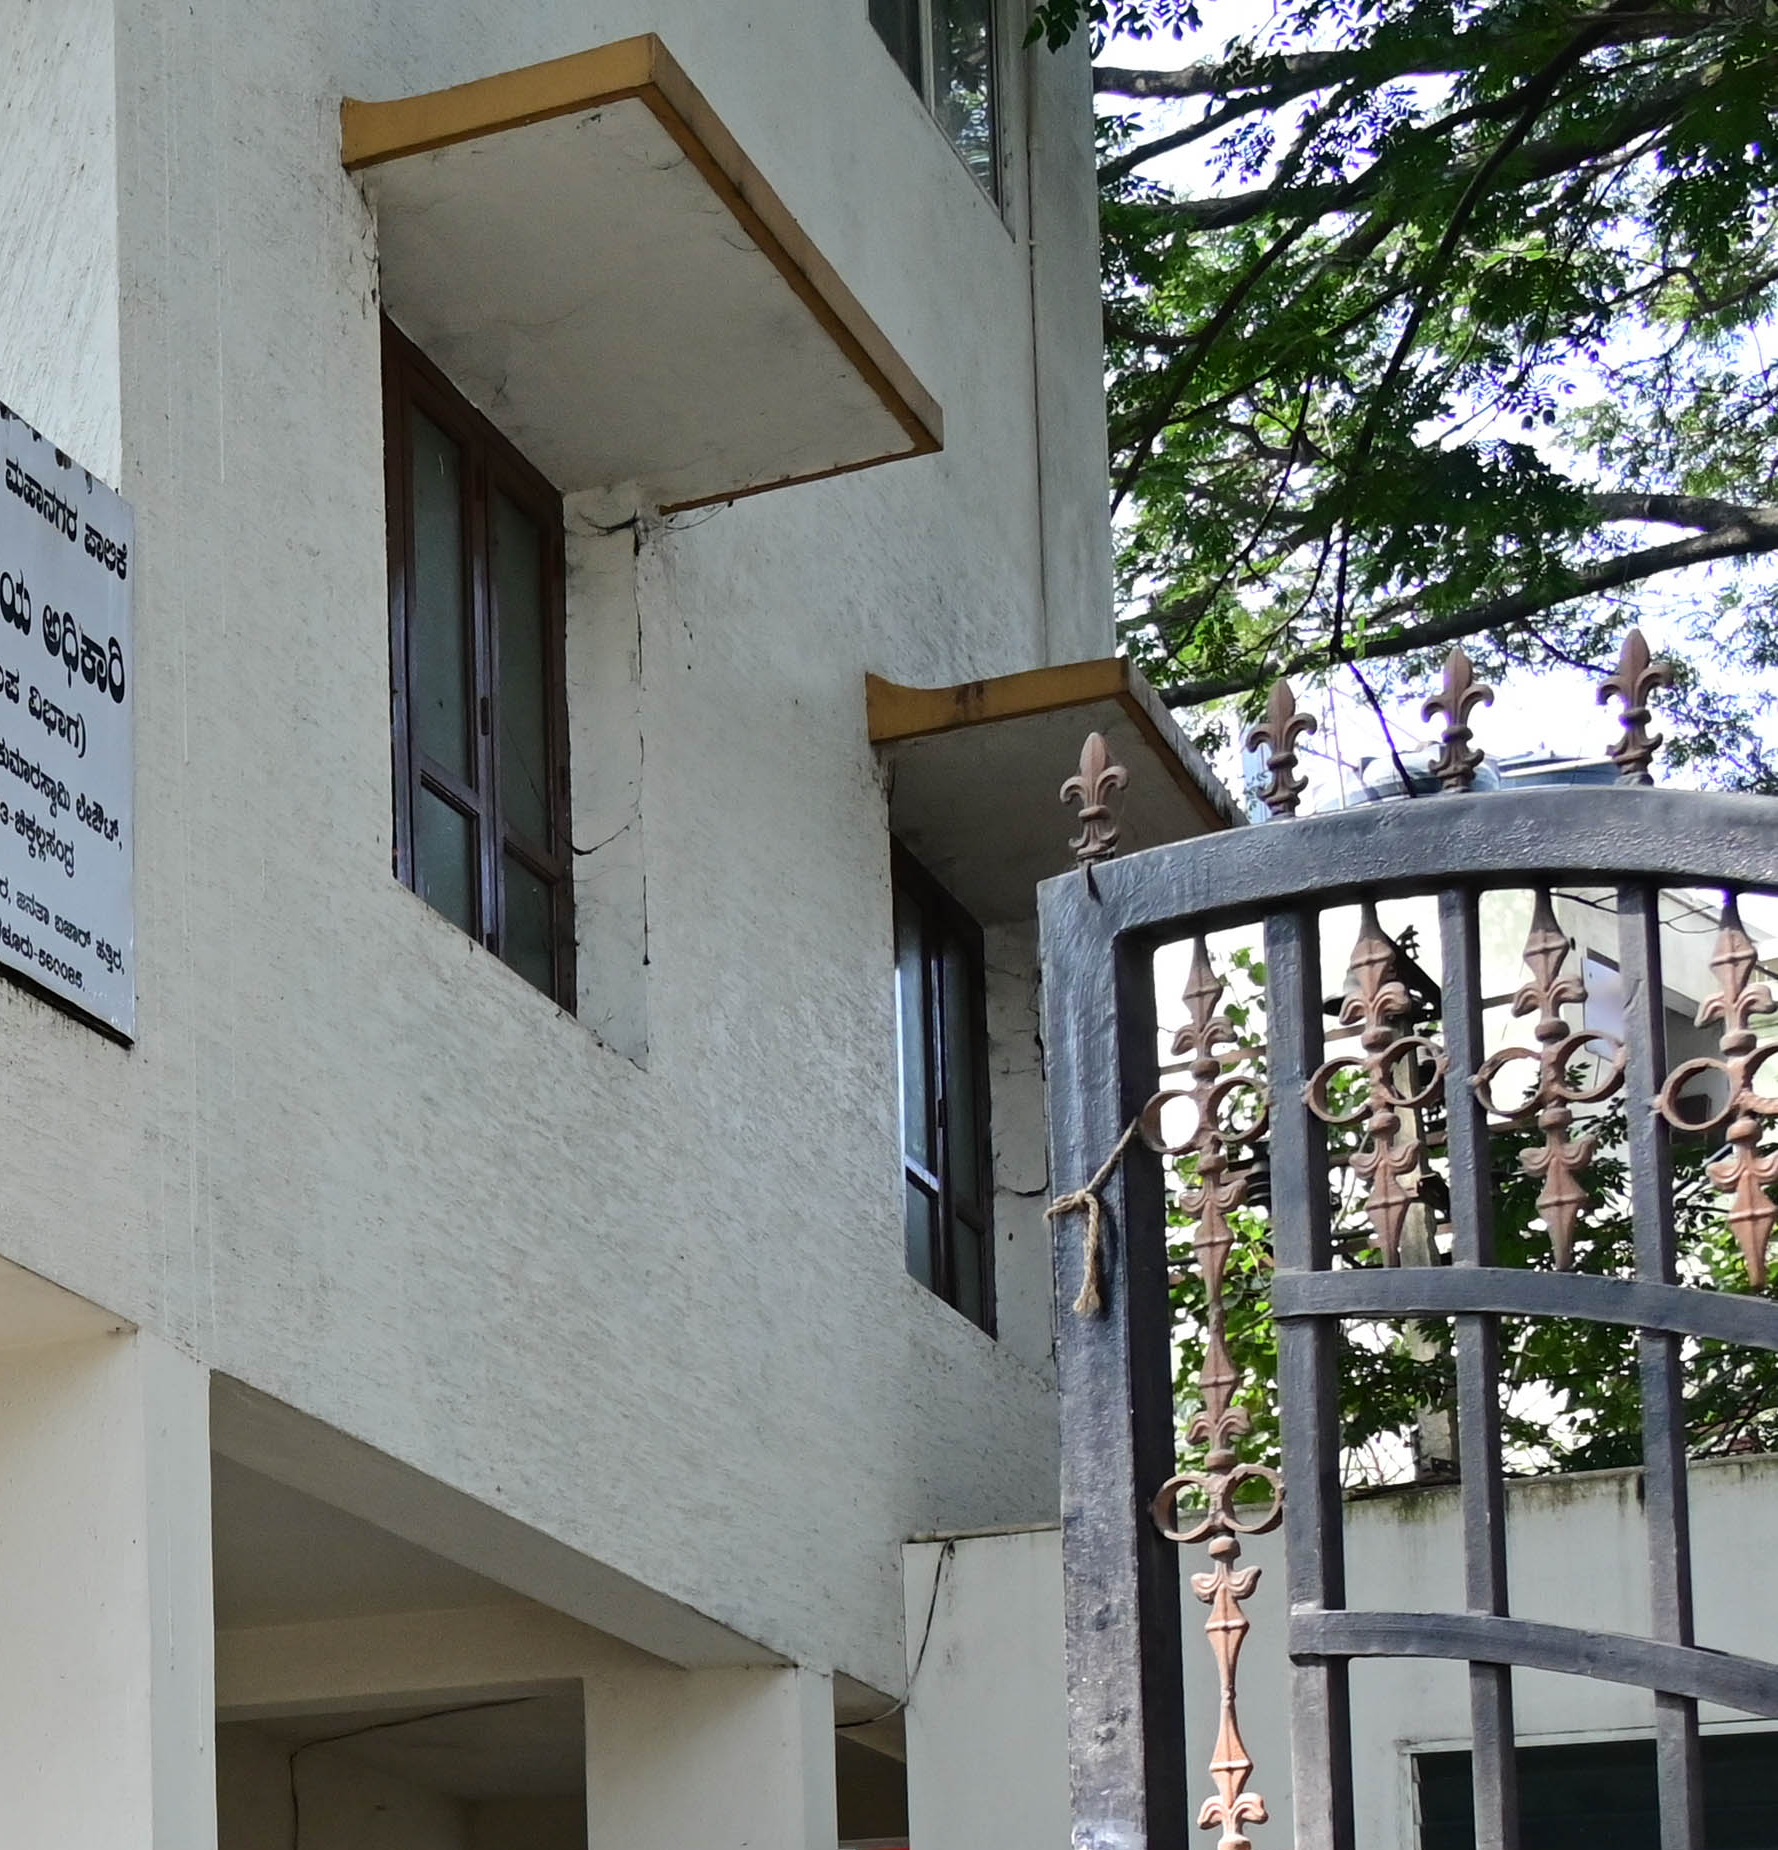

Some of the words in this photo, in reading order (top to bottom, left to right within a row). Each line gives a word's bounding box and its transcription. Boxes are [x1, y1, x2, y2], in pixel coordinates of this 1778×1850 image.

[5, 456, 78, 543] ಮಹಾನಗರ
[84, 522, 128, 581] ಪಾಲಿಕೆ
[43, 604, 126, 704] ಅಧಿಕಾರಿ
